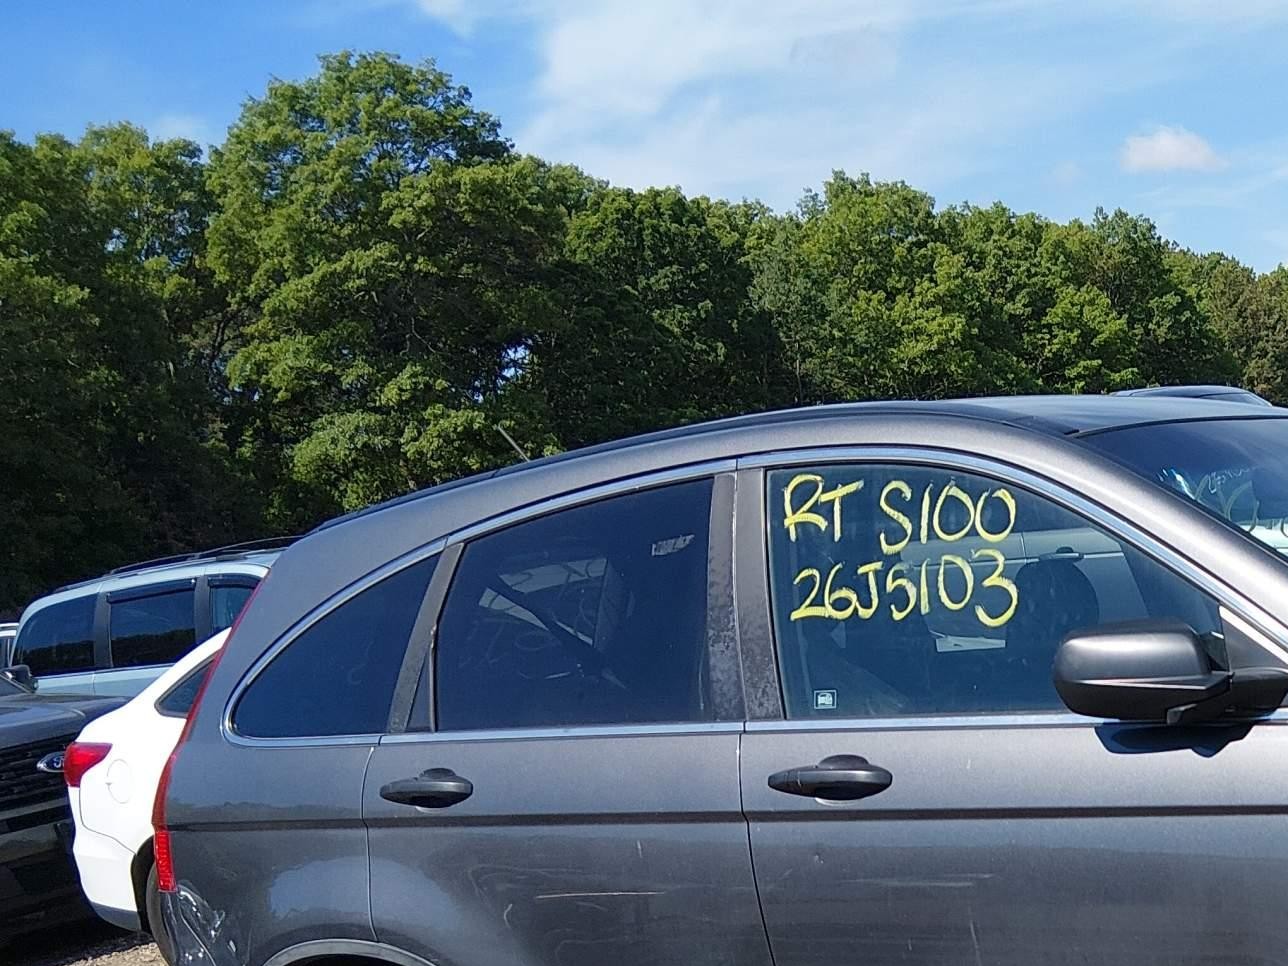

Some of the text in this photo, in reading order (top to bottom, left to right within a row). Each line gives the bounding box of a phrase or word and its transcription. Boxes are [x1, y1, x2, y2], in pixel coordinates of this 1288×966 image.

[783, 474, 1017, 555] RT S100
[790, 549, 1019, 627] 26J5103
